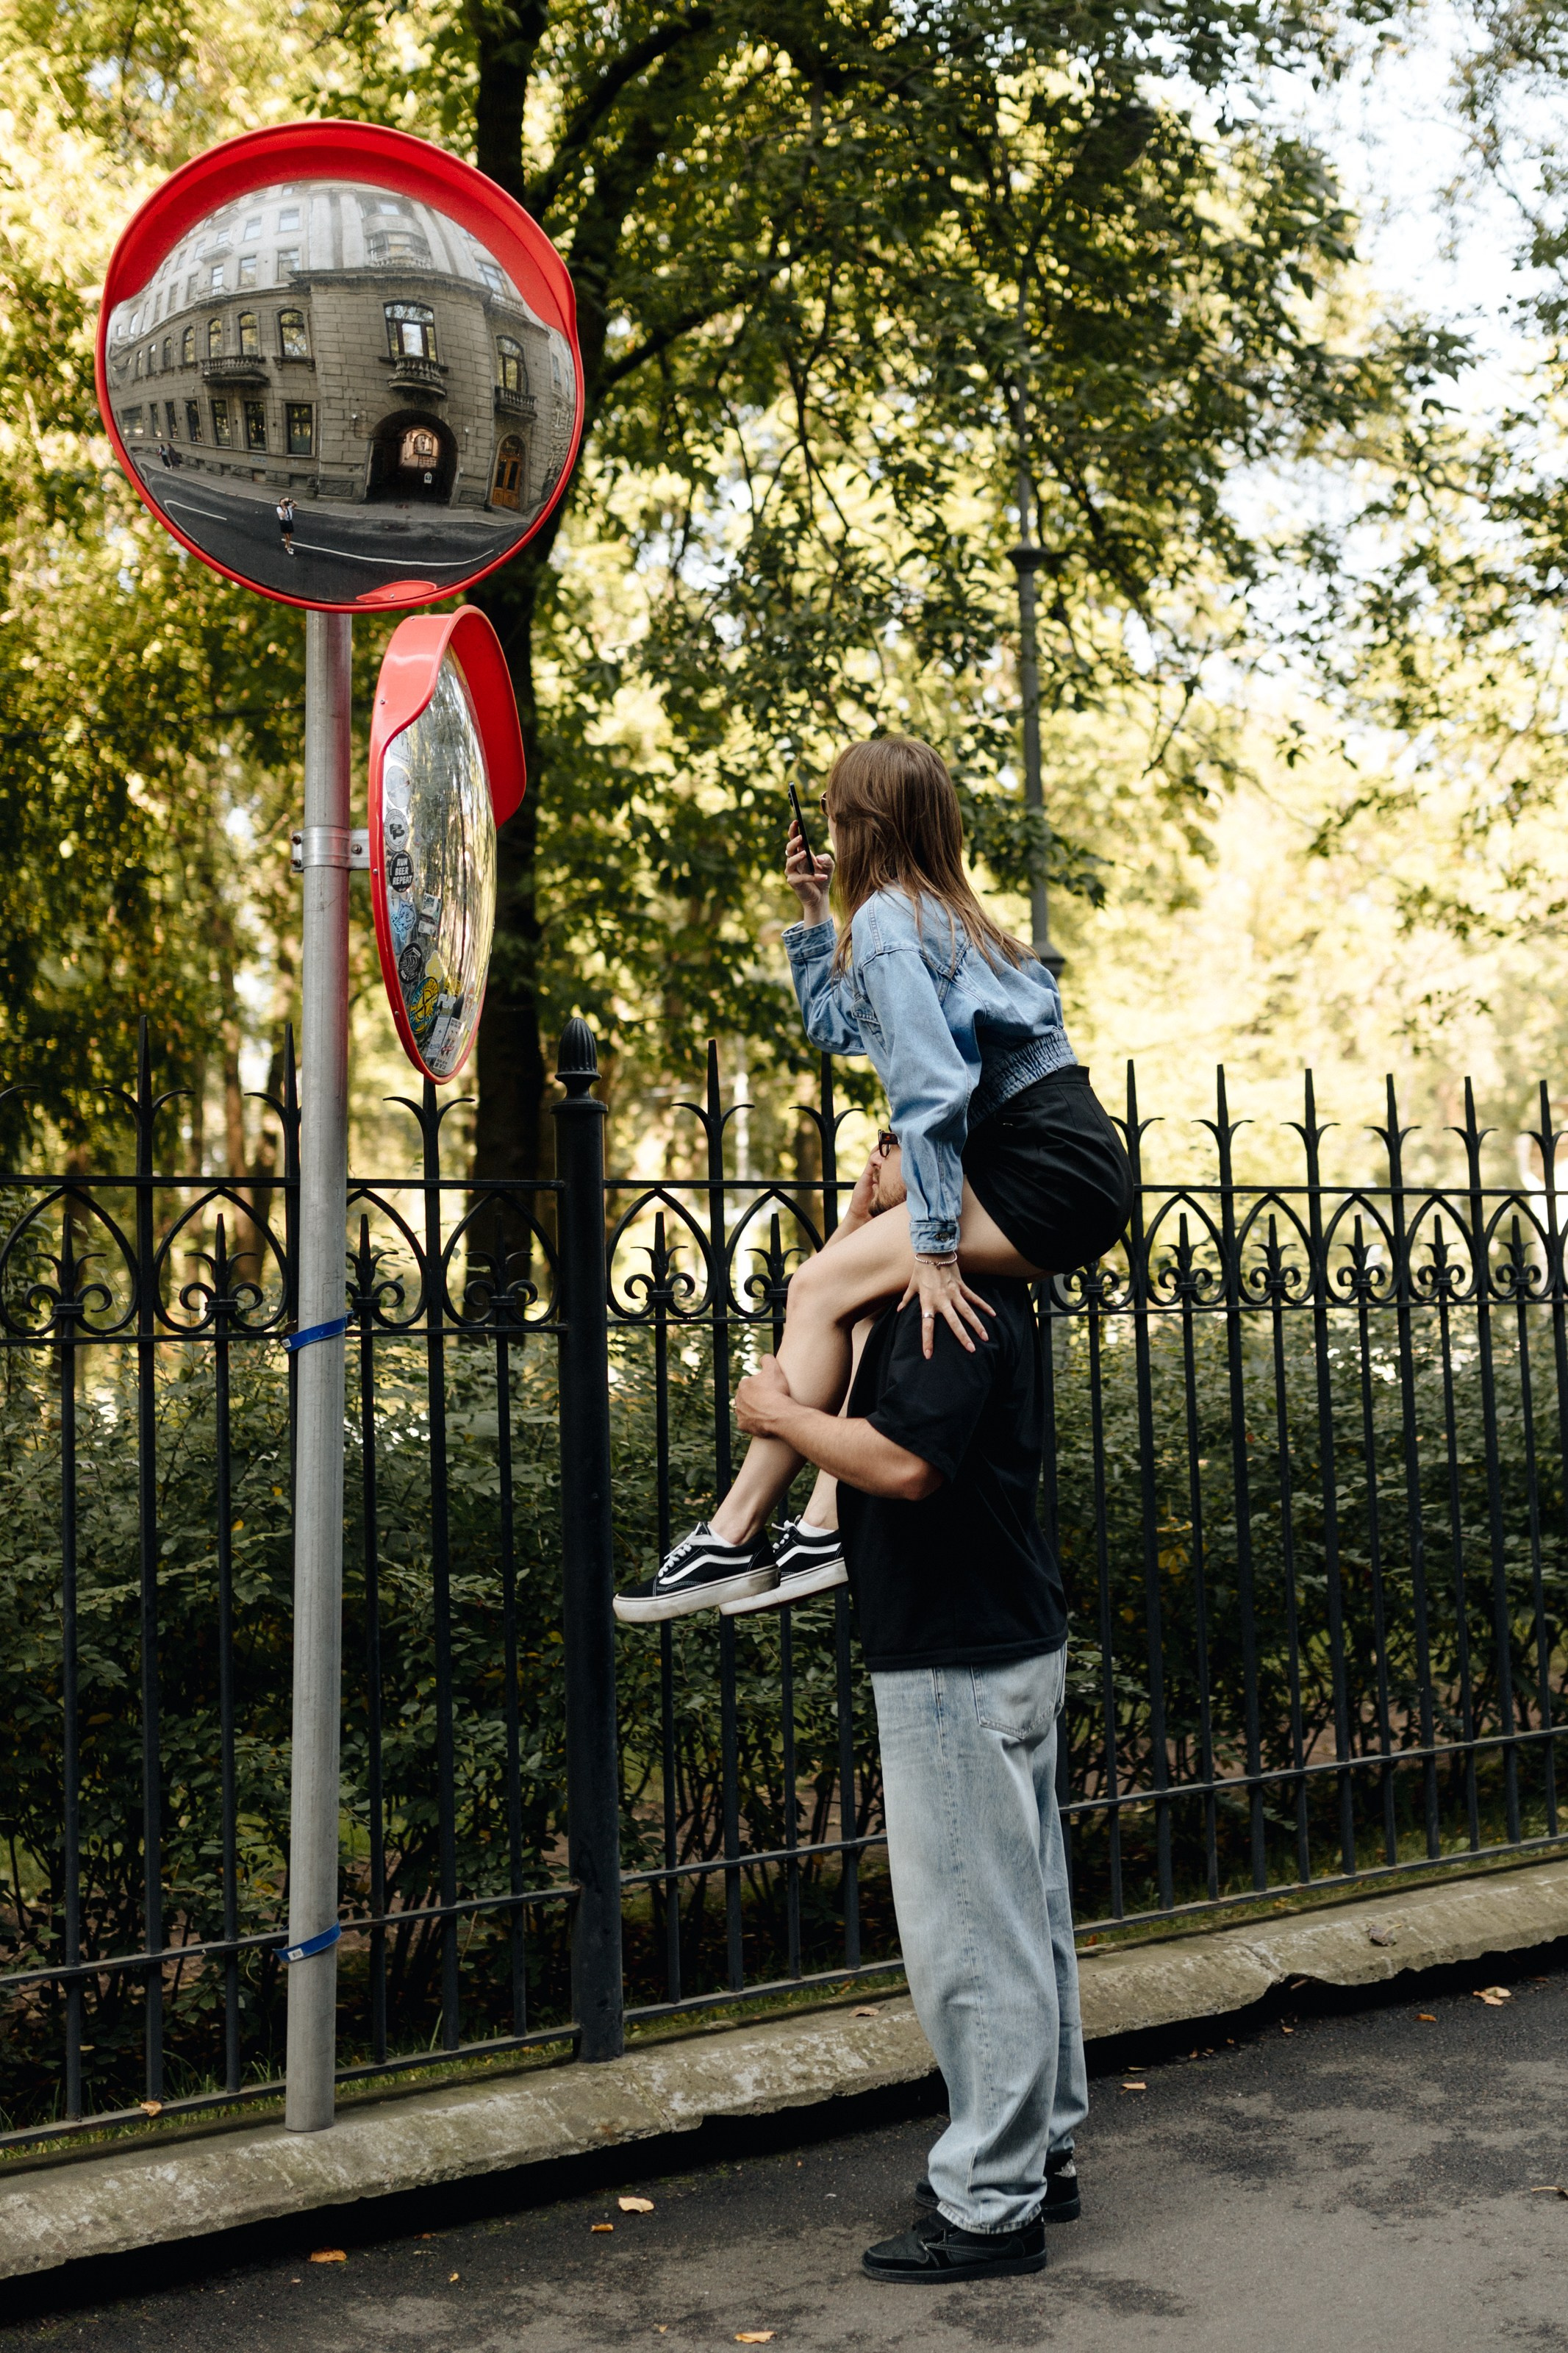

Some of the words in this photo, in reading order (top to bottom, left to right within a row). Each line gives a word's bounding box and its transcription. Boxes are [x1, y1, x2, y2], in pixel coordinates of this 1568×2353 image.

[397, 858, 408, 866] RUN
[395, 867, 409, 876] BEER
[393, 876, 412, 885] REPEAT
